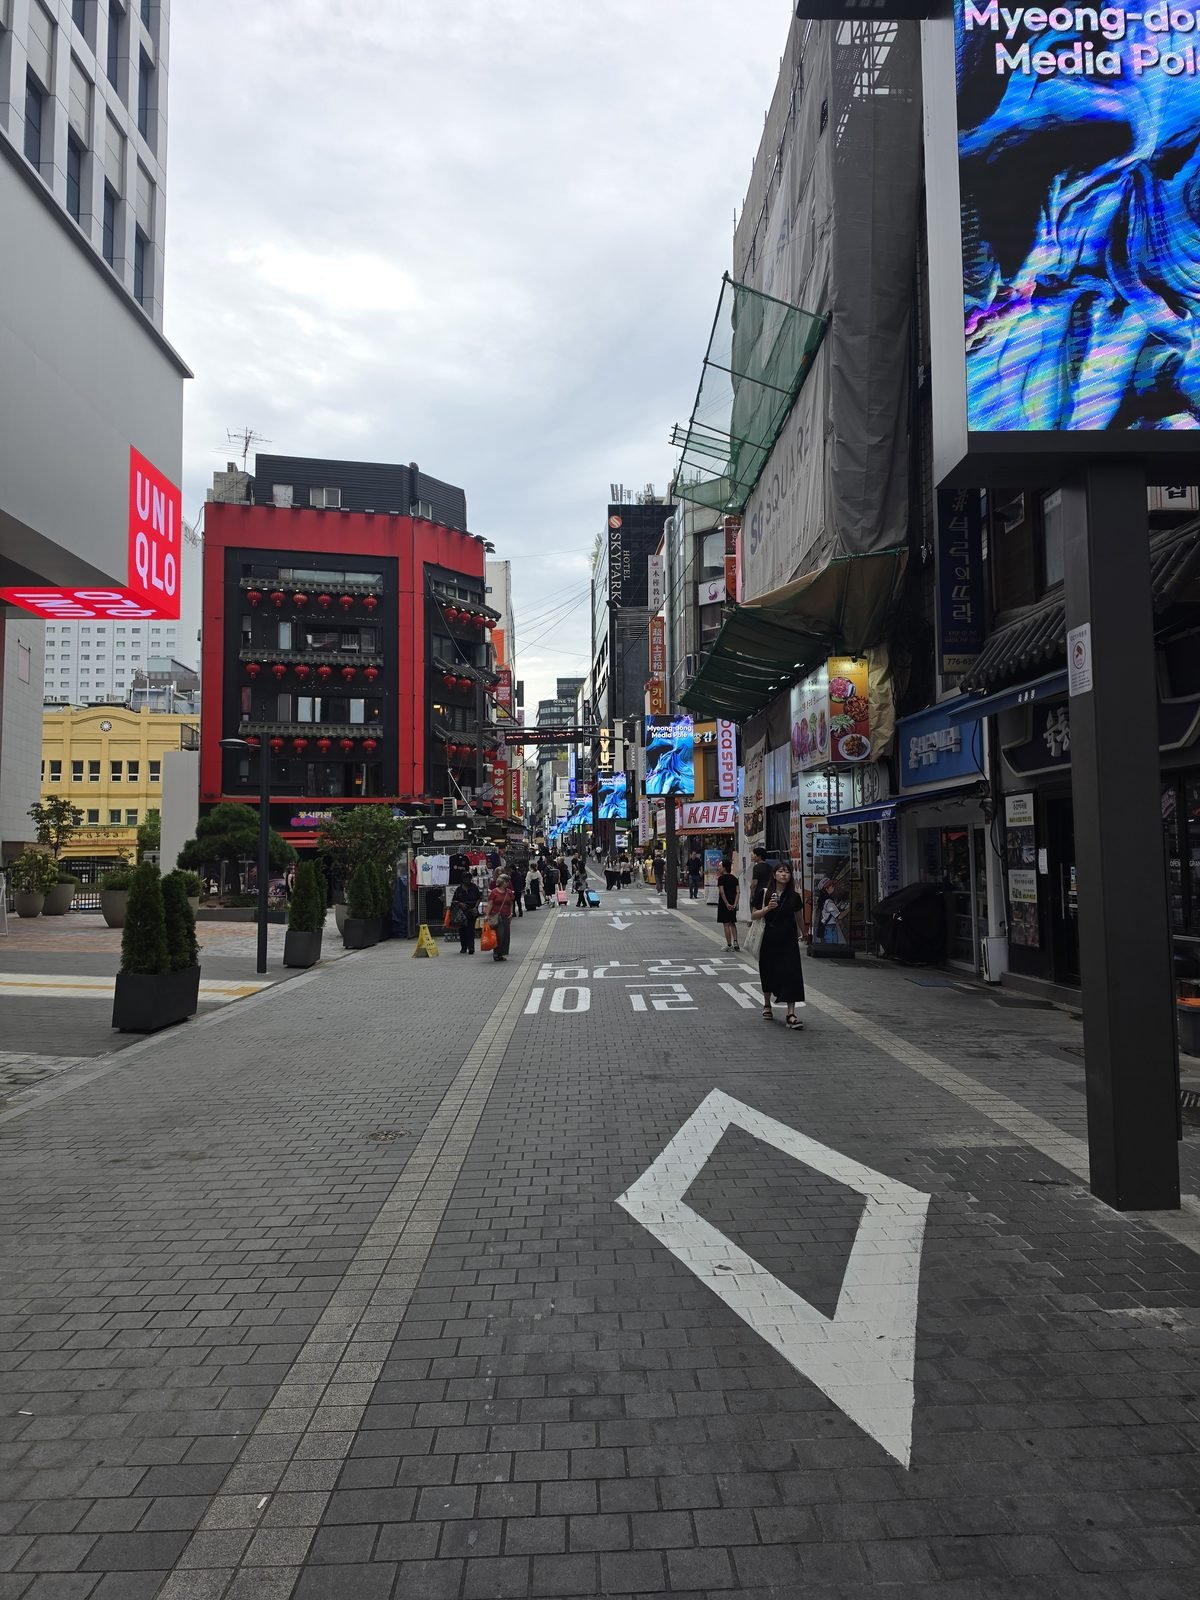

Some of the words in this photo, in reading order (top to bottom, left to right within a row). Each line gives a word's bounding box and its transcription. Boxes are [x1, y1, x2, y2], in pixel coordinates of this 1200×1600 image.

[965, 0, 1200, 40] Myeong-do
[995, 41, 1121, 75] Media
[1135, 42, 1200, 76] Pol
[136, 470, 174, 543] UNI
[135, 531, 176, 597] QLO
[610, 533, 621, 607] SKYPARK
[537, 957, 760, 980] 보호구역
[523, 981, 806, 1014] 어린이
